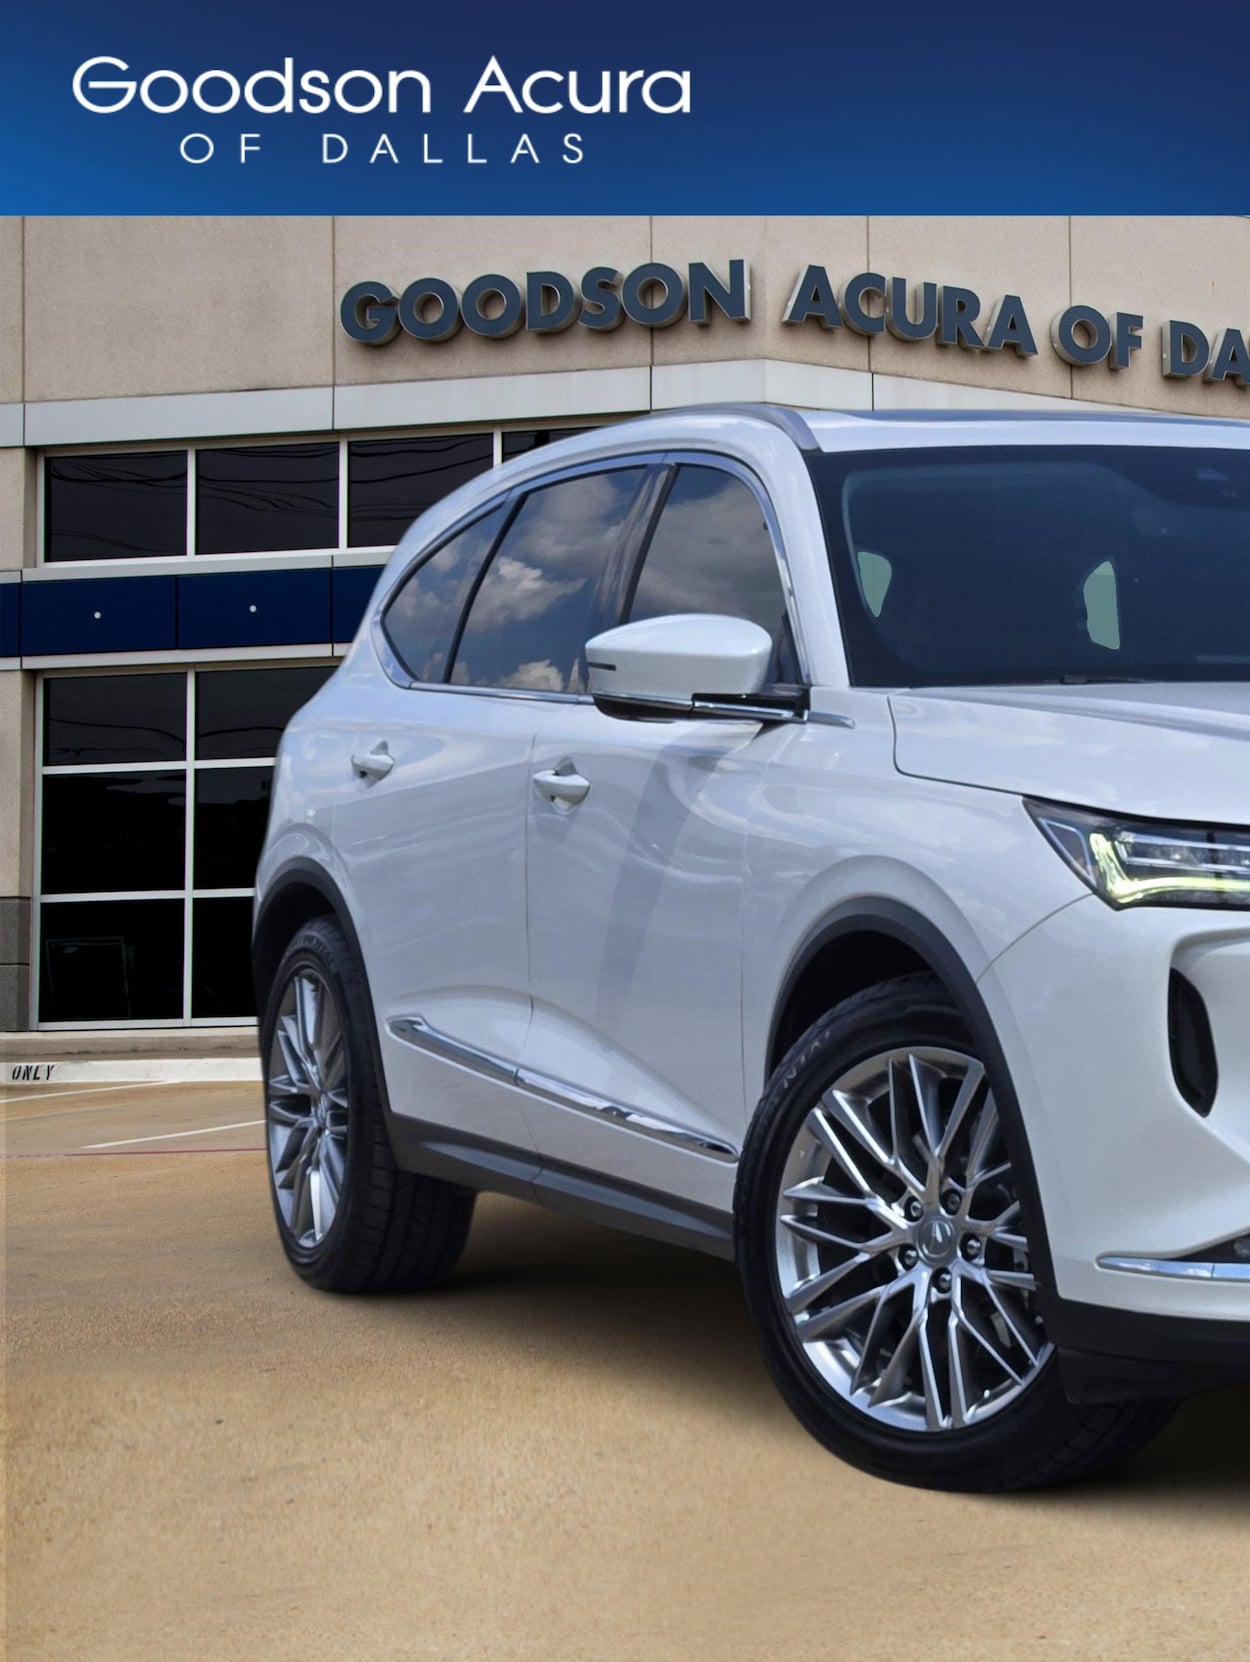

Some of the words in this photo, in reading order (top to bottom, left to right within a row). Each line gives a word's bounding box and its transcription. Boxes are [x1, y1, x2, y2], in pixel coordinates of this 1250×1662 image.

[340, 259, 751, 346] GOODSON
[782, 264, 1038, 357] ACURA
[1051, 304, 1144, 370] OF
[11, 1064, 55, 1081] ONLY
